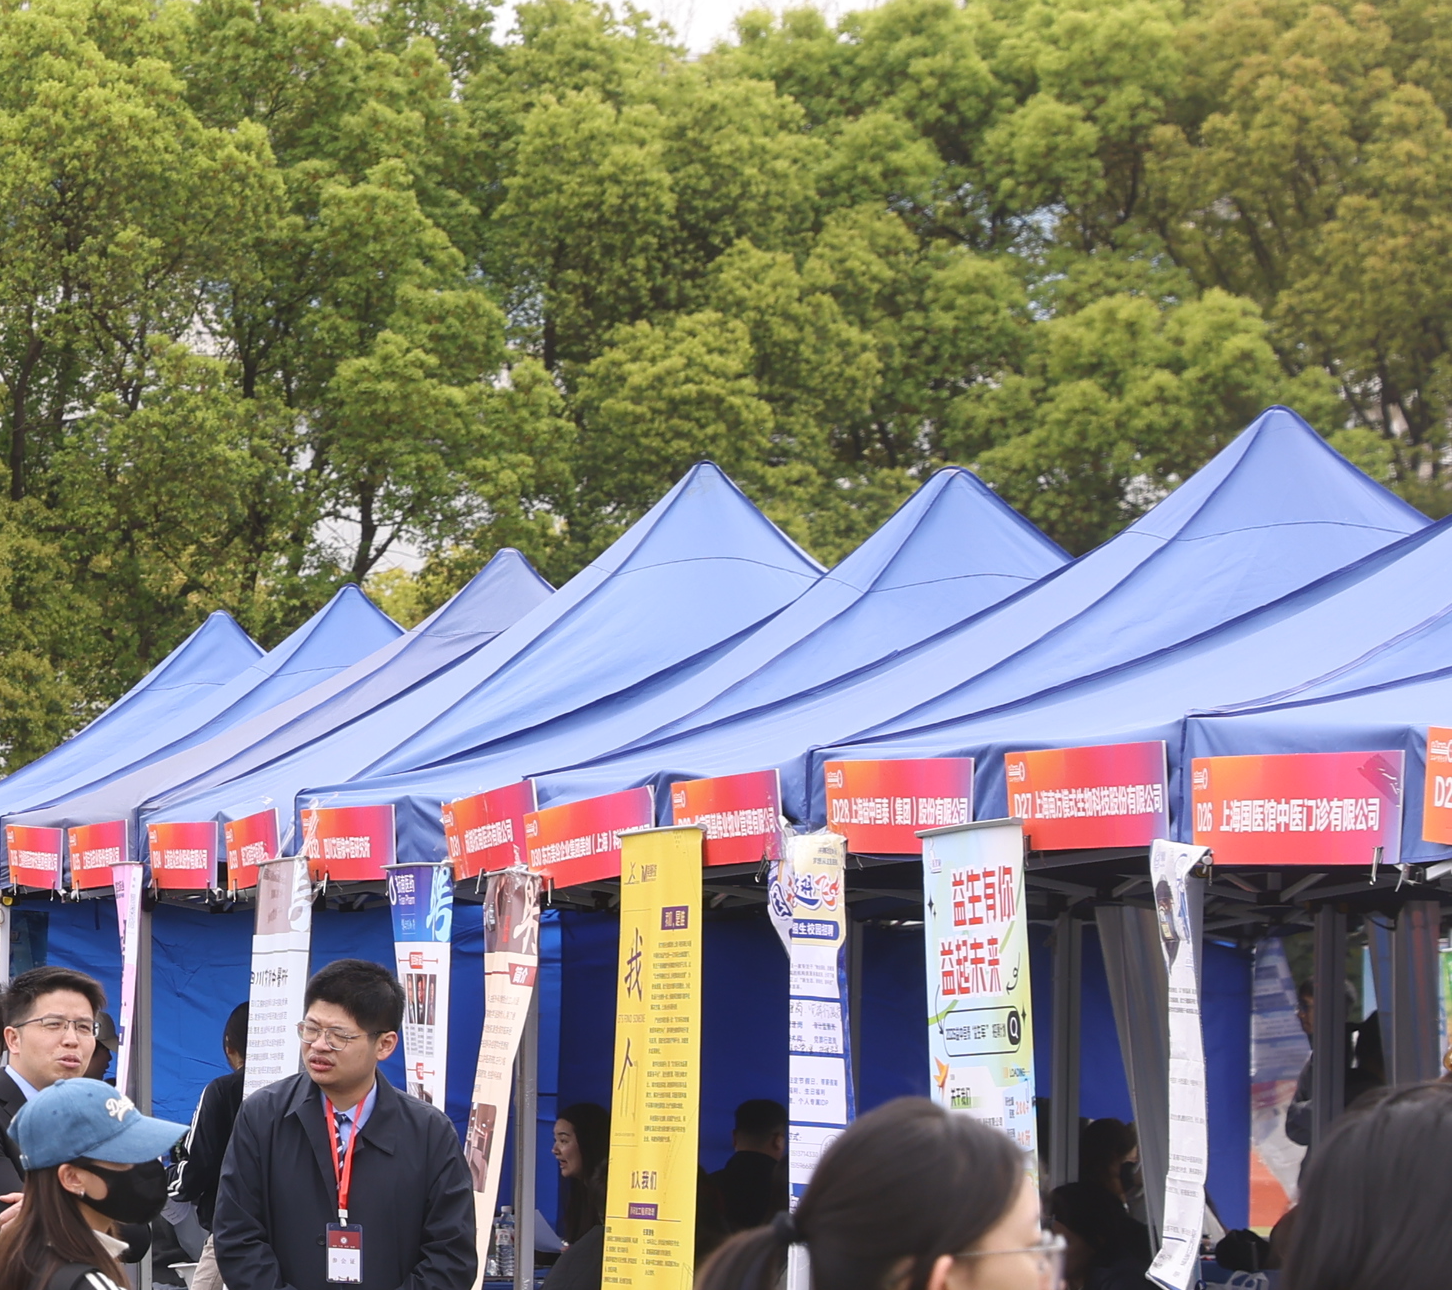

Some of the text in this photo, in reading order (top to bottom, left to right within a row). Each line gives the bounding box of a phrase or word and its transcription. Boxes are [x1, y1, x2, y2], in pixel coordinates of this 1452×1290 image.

[1014, 784, 1163, 820] D27 上海南方模式生物科技股份有限公司
[1434, 775, 1452, 809] D2
[832, 797, 850, 824] D28
[1196, 797, 1381, 833] D26 上海国医馆中医门诊有限公司
[951, 866, 1015, 927] 益生有你
[940, 936, 1002, 996] 益起未来
